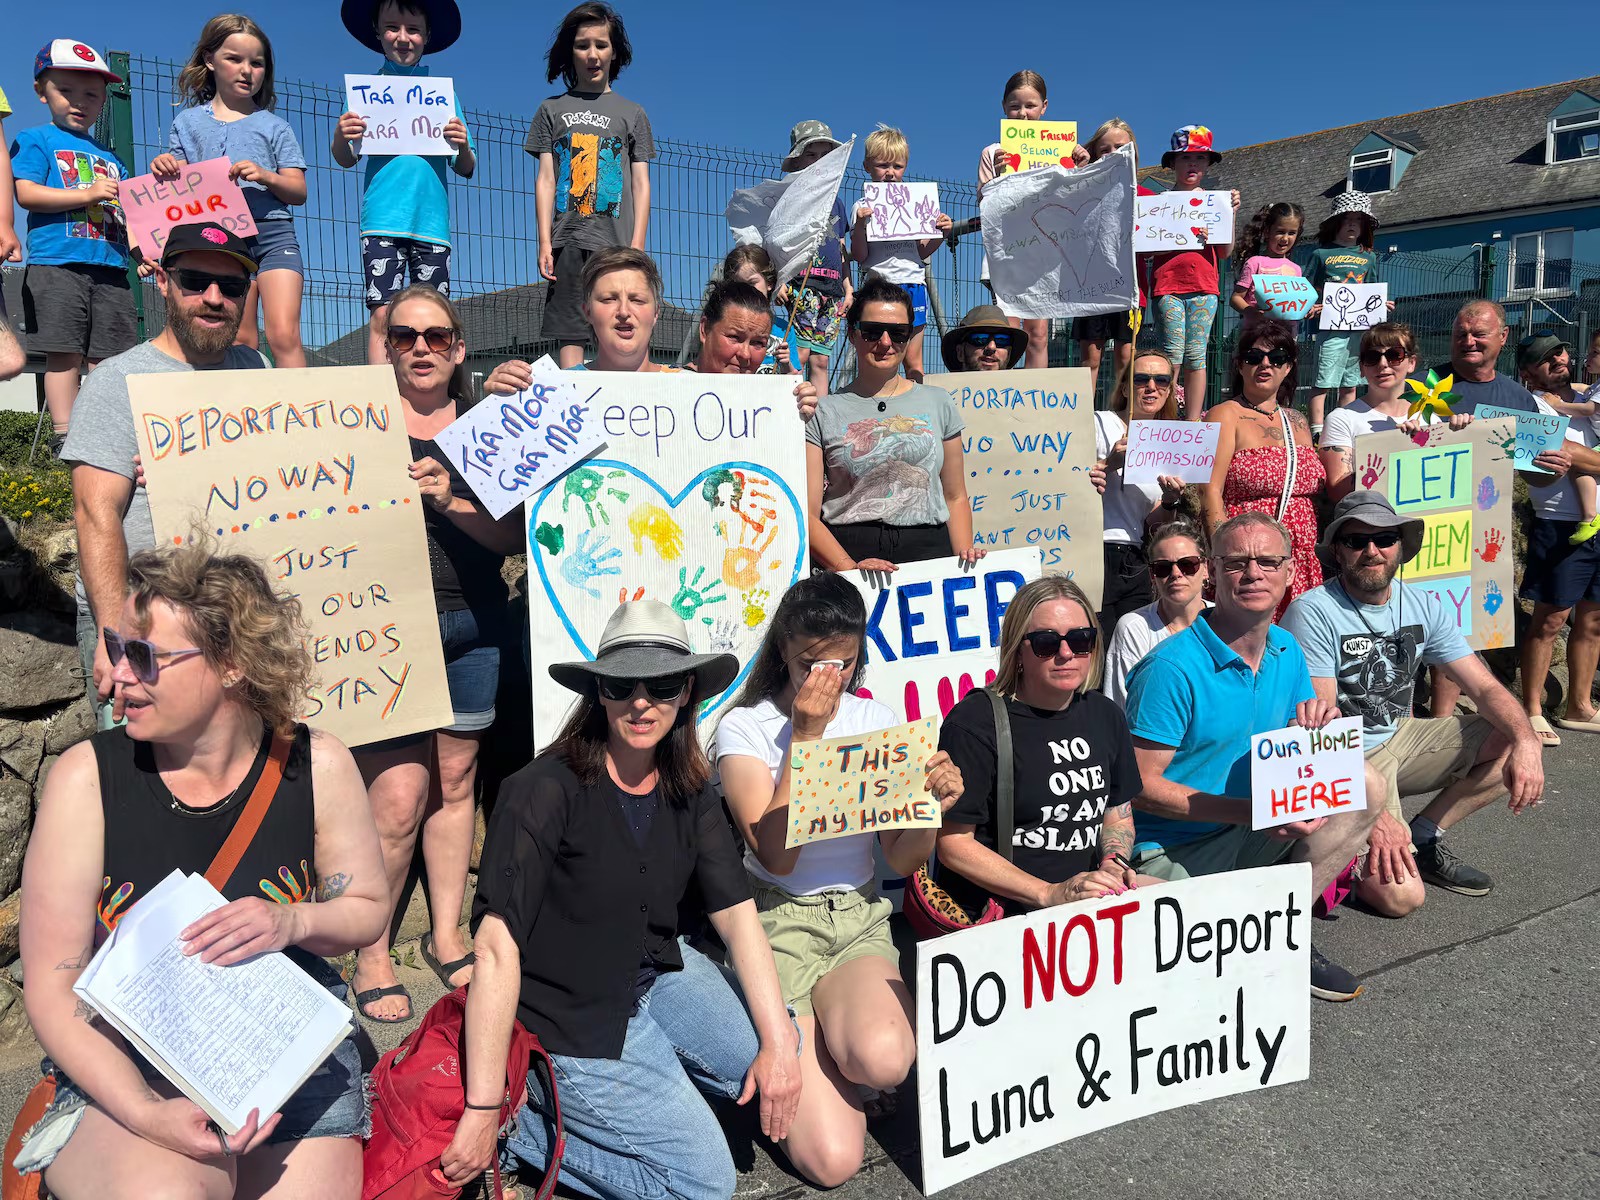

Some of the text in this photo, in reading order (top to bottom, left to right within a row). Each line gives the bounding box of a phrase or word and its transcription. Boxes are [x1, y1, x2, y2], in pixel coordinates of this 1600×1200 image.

[352, 85, 449, 106] TRÁ MÓR
[412, 115, 442, 138] MÓ
[1006, 127, 1076, 142] OUR FRIENDS
[1020, 143, 1059, 157] BELONG
[130, 171, 202, 206] HELP
[165, 194, 228, 221] OUR
[1137, 202, 1171, 219] Let
[1077, 286, 1098, 301] THE
[1262, 278, 1309, 294] LET US
[1264, 298, 1308, 313] STAY
[142, 400, 390, 461] DEPORTATION
[462, 383, 557, 477] TRÁ MÓR
[585, 387, 772, 457] eep Our
[1138, 426, 1206, 444] CHOOSE
[498, 404, 590, 491] GRÁ MÓR
[1009, 431, 1073, 464] WAY
[1127, 449, 1214, 468] COMPASSION
[205, 453, 356, 516] NO WAY
[1395, 449, 1470, 506] LET
[968, 489, 1068, 512] E JUST
[973, 523, 1071, 545] ANT OUR
[1402, 519, 1470, 571] HEM
[272, 543, 359, 579] JUST
[321, 583, 391, 616] OUR
[863, 570, 1026, 665] KEEP
[1346, 640, 1370, 651] KUNST
[1048, 737, 1091, 764] NO
[1257, 729, 1360, 760] OUR HOME
[1049, 765, 1105, 796] ONE
[1297, 763, 1314, 779] IS
[858, 778, 890, 804] IS
[1271, 778, 1352, 818] HERE
[808, 801, 934, 834] MY HOME
[1040, 794, 1109, 825] IS AN
[1011, 822, 1103, 851] ISLAN
[931, 891, 1301, 1044] Do NOT Deport
[939, 986, 1287, 1159] Luna & Family
